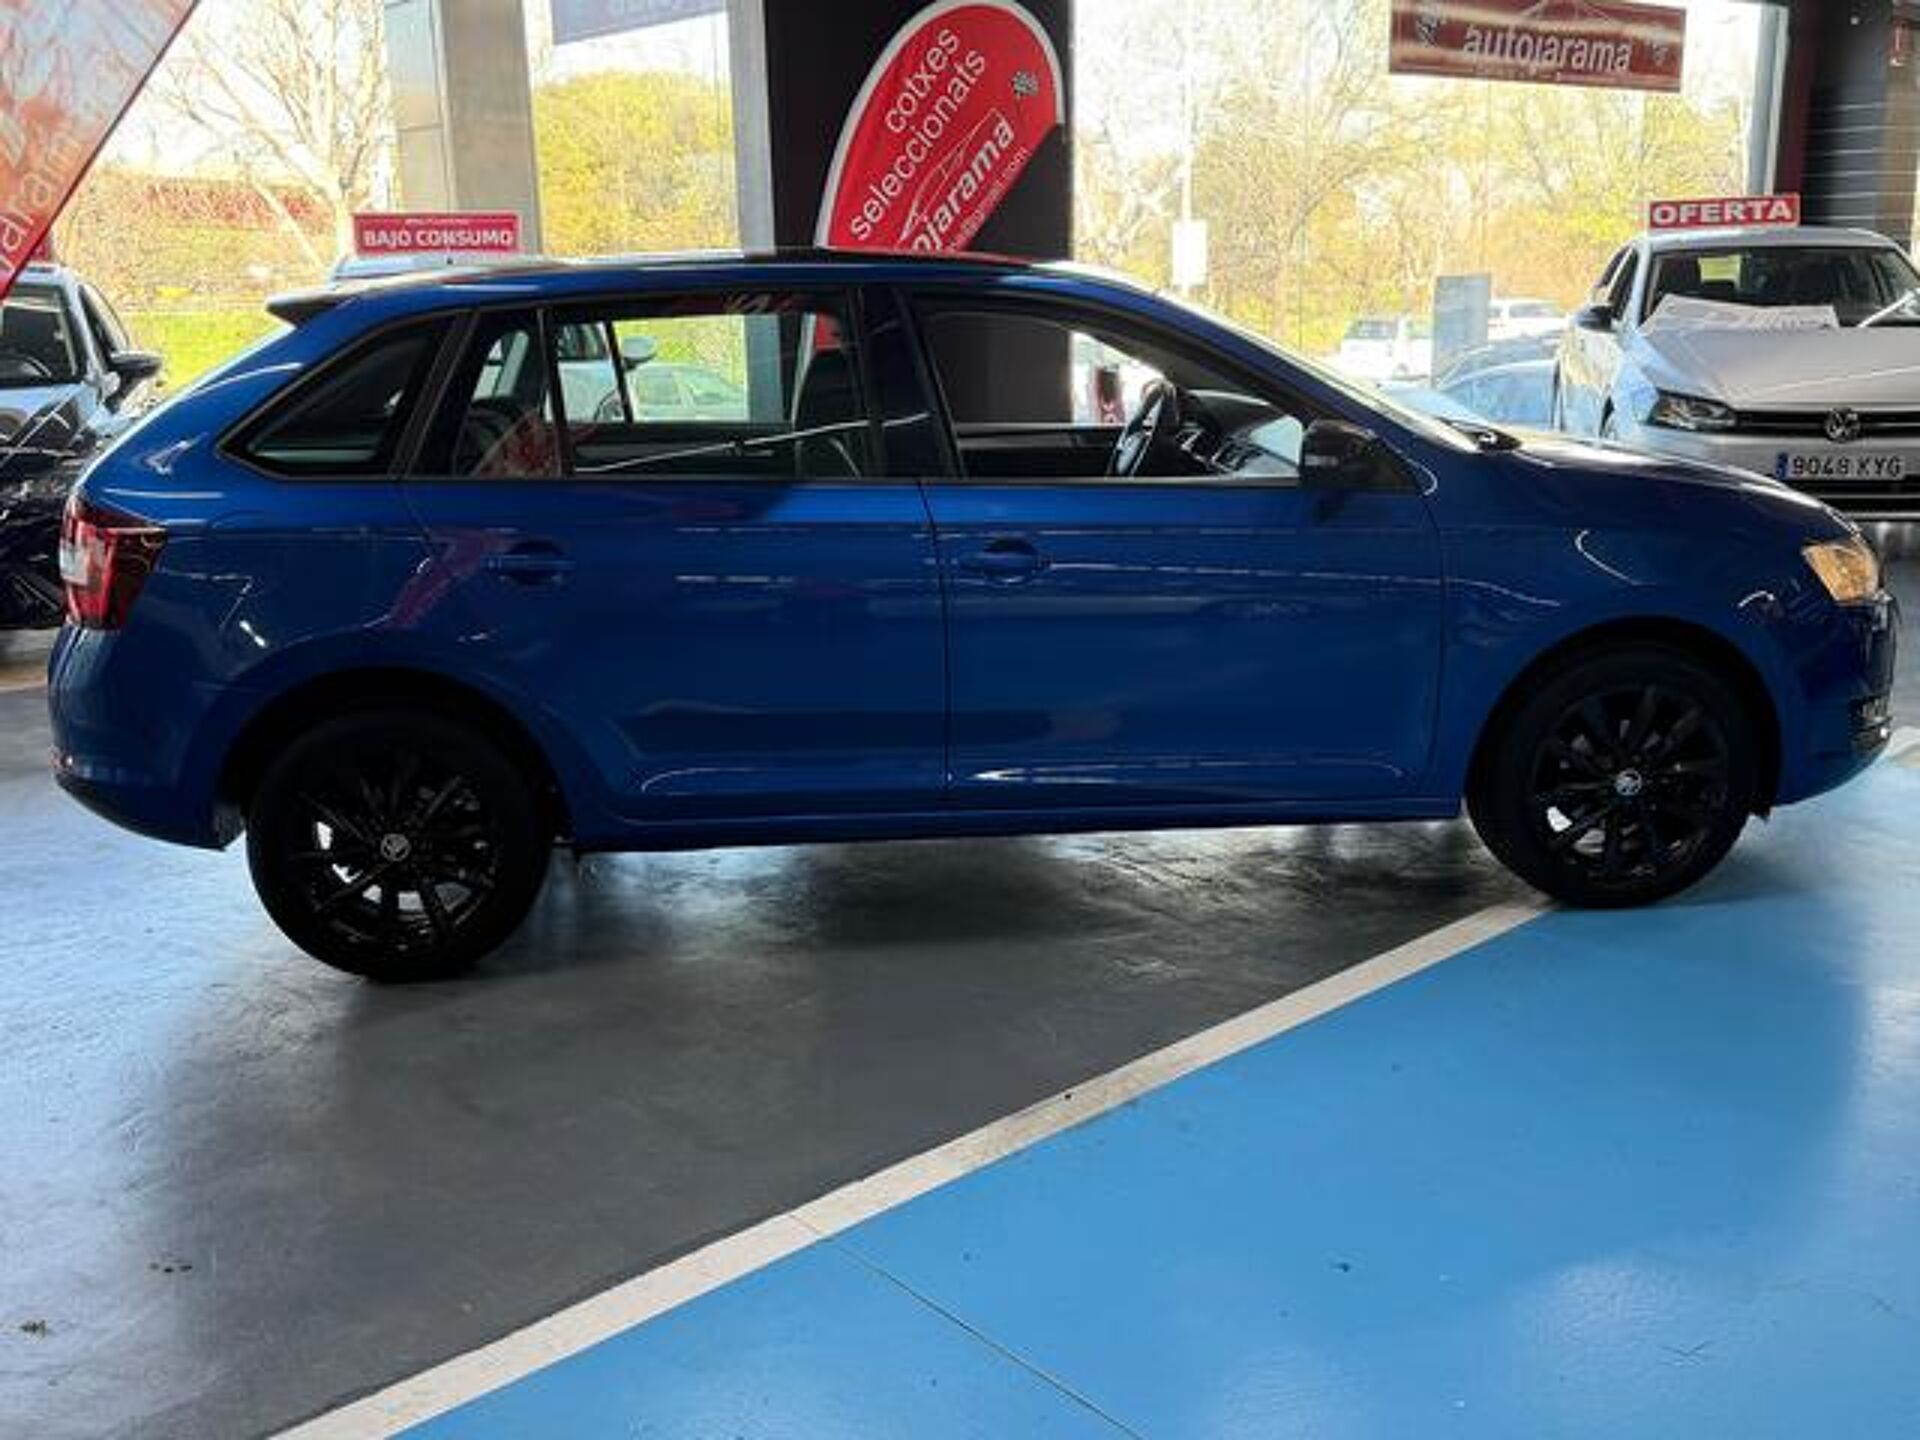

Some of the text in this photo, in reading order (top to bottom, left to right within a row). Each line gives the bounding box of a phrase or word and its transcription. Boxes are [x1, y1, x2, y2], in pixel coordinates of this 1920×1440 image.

[885, 28, 960, 134] cotxes
[1463, 24, 1633, 75] autojarama
[850, 50, 987, 241] seleccionats
[911, 116, 1015, 251] ojarama
[363, 229, 514, 249] BAJO CONSUMO
[1651, 199, 1793, 226] OFERTA
